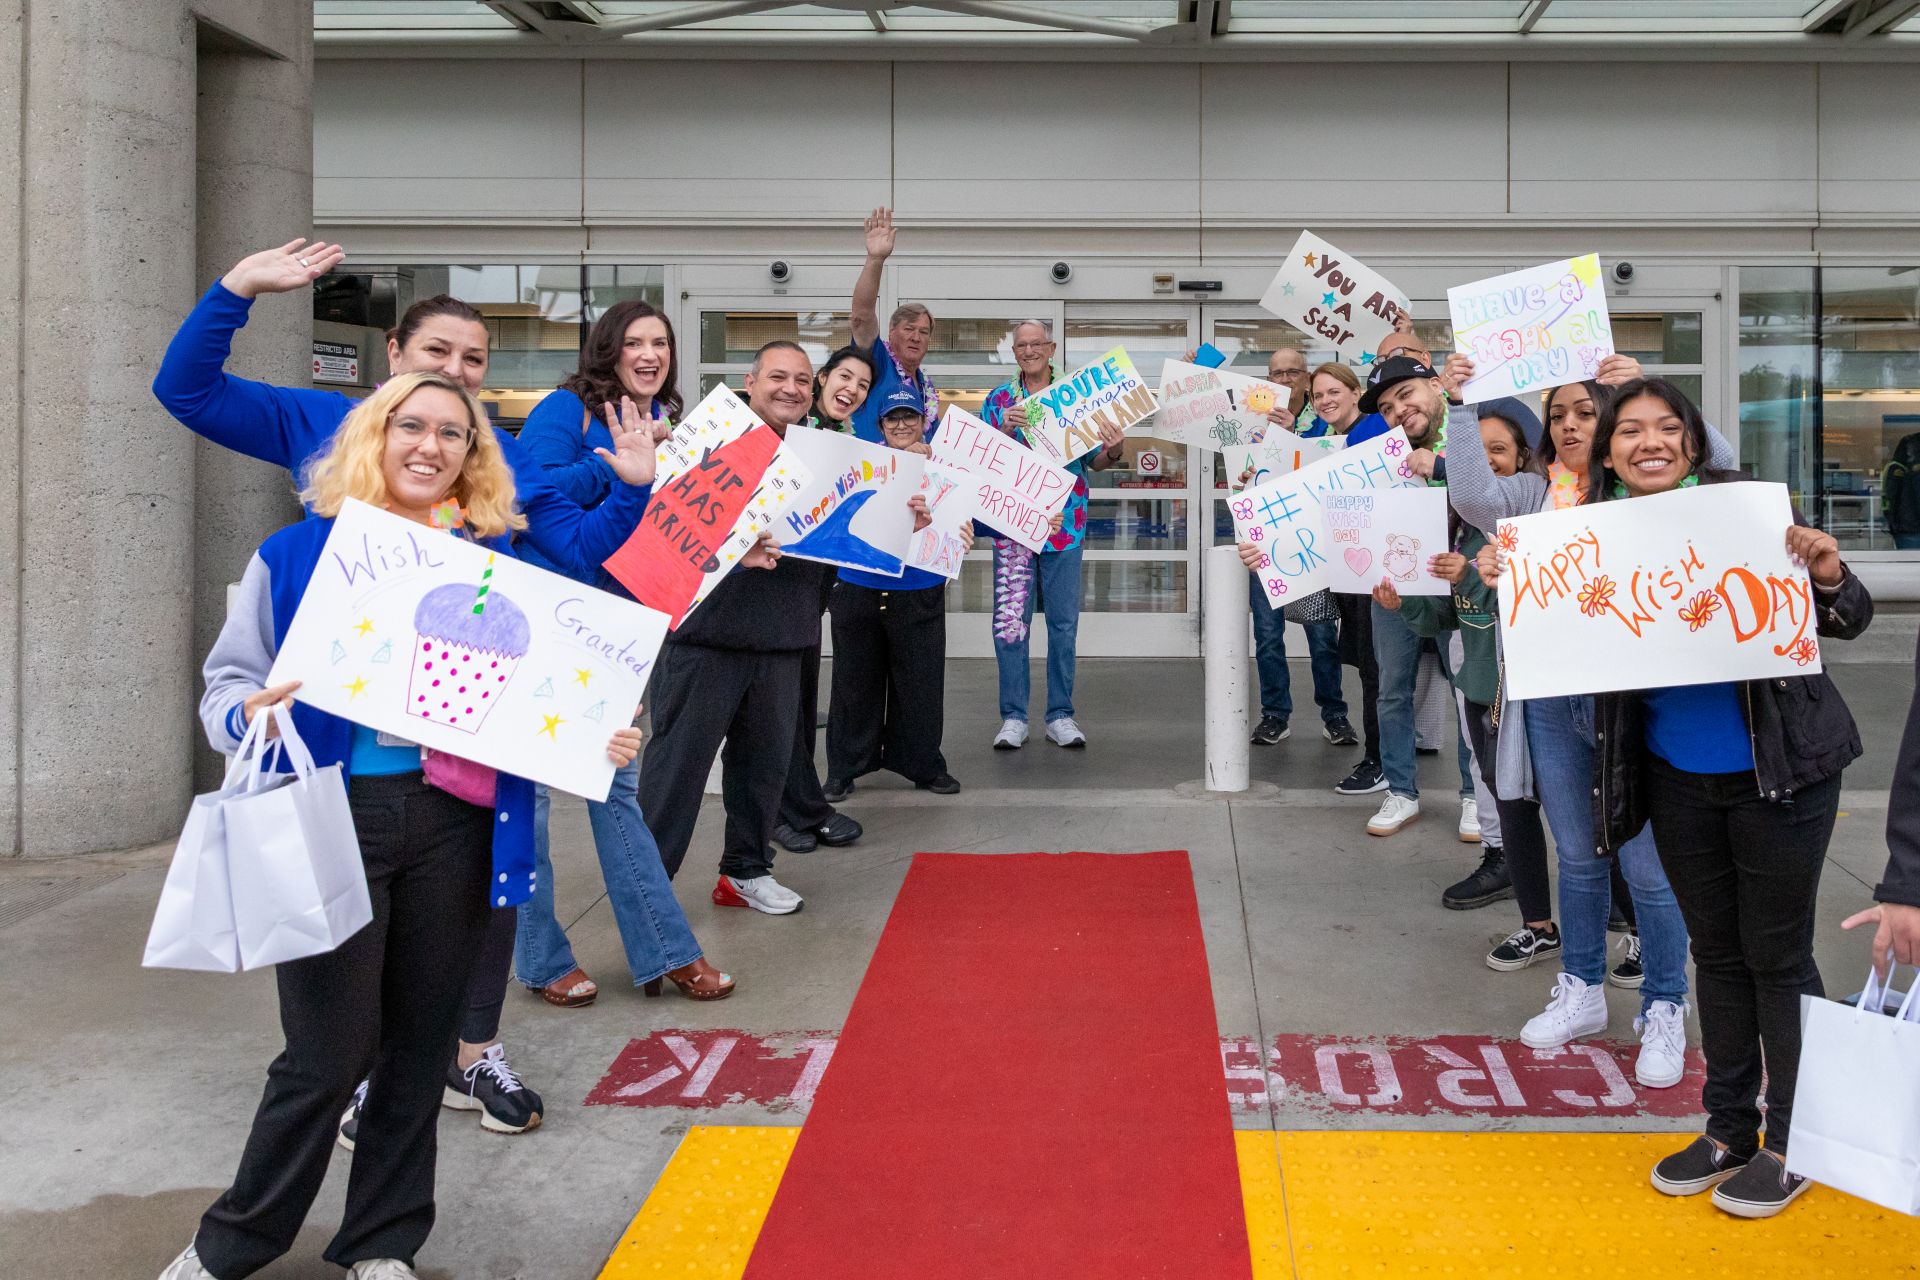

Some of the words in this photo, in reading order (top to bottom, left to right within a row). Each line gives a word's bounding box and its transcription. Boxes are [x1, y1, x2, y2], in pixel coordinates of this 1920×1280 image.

[1333, 302, 1352, 323] A
[313, 343, 342, 354] RESTRICTED
[343, 347, 356, 356] AREA
[700, 446, 744, 492] VIP
[672, 474, 725, 526] HAS
[978, 484, 1051, 544] ARRIVED
[646, 500, 721, 574] RRIVED
[333, 531, 444, 587] Wish
[554, 598, 650, 677] Granted
